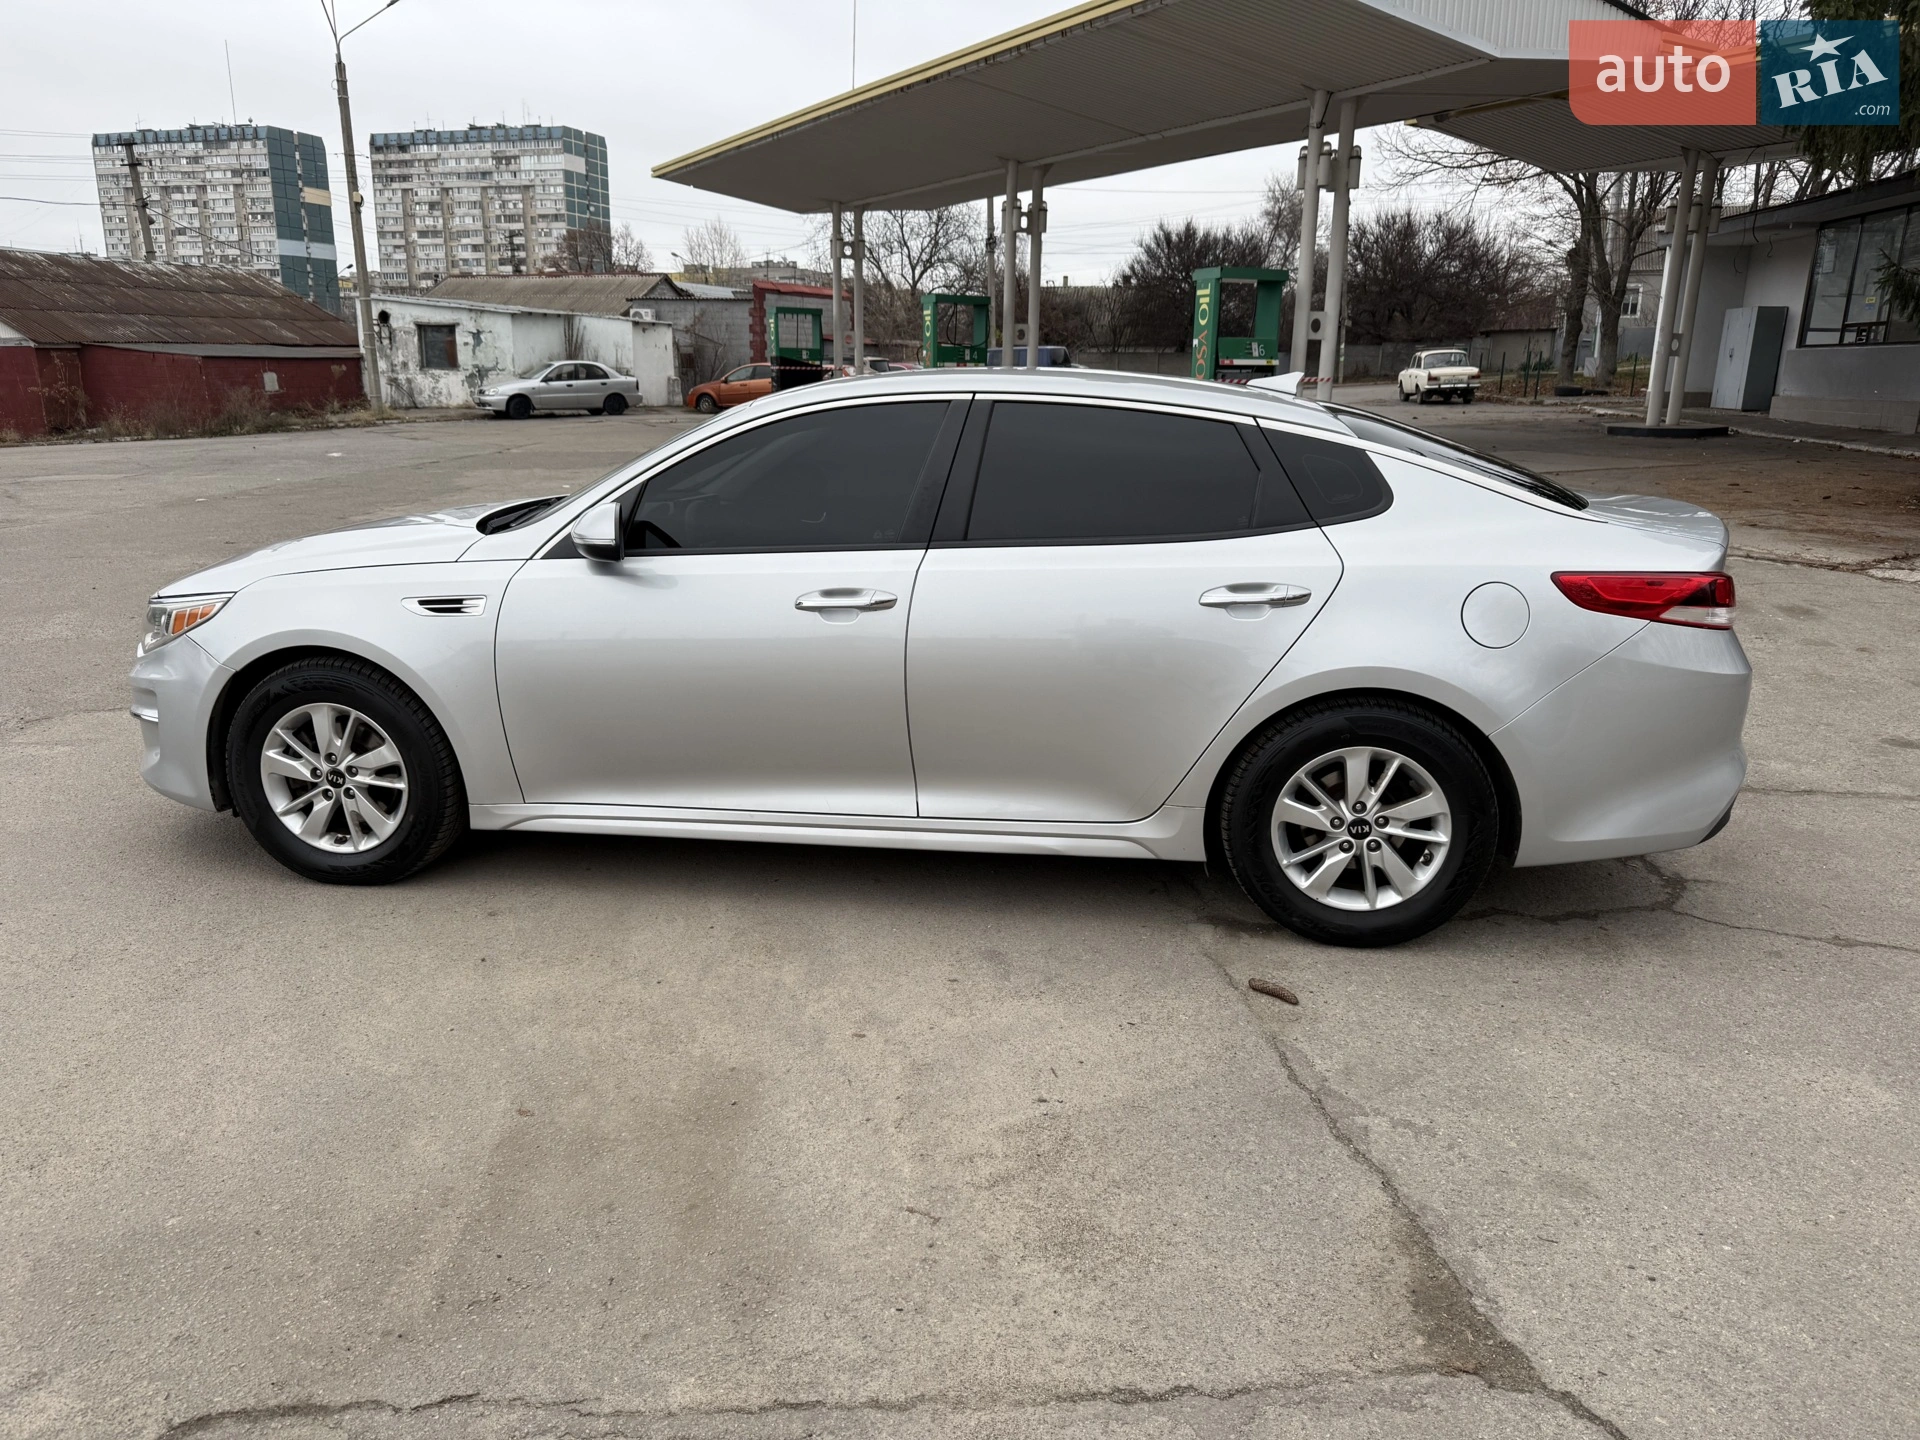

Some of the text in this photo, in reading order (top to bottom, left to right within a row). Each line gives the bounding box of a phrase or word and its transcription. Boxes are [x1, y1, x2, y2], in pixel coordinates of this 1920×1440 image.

[1196, 282, 1211, 326] OIL
[923, 305, 932, 337] OIL
[972, 350, 978, 360] 4
[1258, 344, 1266, 356] 6
[327, 772, 344, 785] KIA
[1349, 824, 1370, 834] KIA
